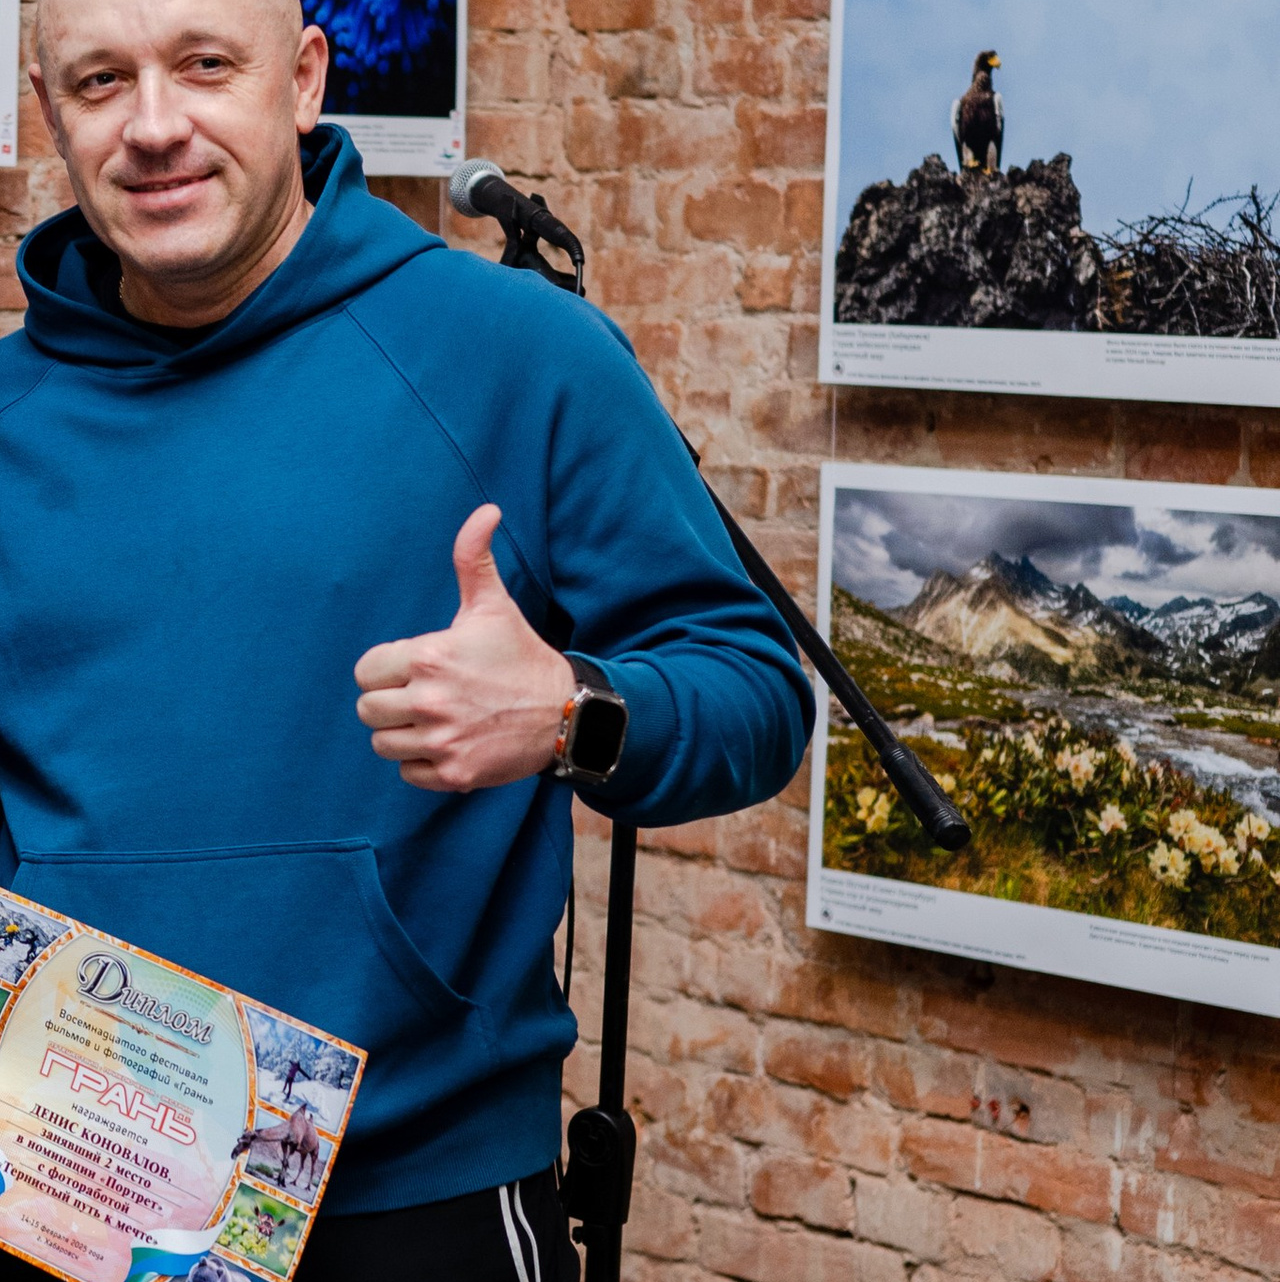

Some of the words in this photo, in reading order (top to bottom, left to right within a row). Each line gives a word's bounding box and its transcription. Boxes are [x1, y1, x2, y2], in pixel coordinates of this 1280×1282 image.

[76, 950, 215, 1045] Диплом
[44, 1019, 91, 1047] фильмов
[93, 1043, 100, 1051] и
[103, 1046, 170, 1084] фотографий
[173, 1081, 213, 1105] «Грань»
[59, 1008, 146, 1056] Восемнадцатого
[149, 1051, 208, 1085] фестиваля
[39, 1047, 196, 1146] ГРАНЬ
[71, 1102, 148, 1145] награждается
[16, 1134, 23, 1143] в
[27, 1140, 96, 1179] номинации
[100, 1175, 162, 1210] «Портрет»
[30, 1103, 78, 1133] ДЕНИС
[80, 1127, 171, 1182] КОНОВАЛОВ,
[40, 1128, 101, 1163] занявший
[104, 1157, 112, 1168] 2
[116, 1165, 151, 1188] место
[37, 1163, 45, 1171] с
[47, 1166, 129, 1214] фотоработой
[73, 1198, 100, 1218] путь
[104, 1214, 110, 1224] к
[115, 1220, 157, 1244] мечте»
[40, 1225, 69, 1243] февраля
[70, 1238, 87, 1252] 2025
[88, 1249, 104, 1261] года
[45, 1237, 78, 1259] Хабаровск
